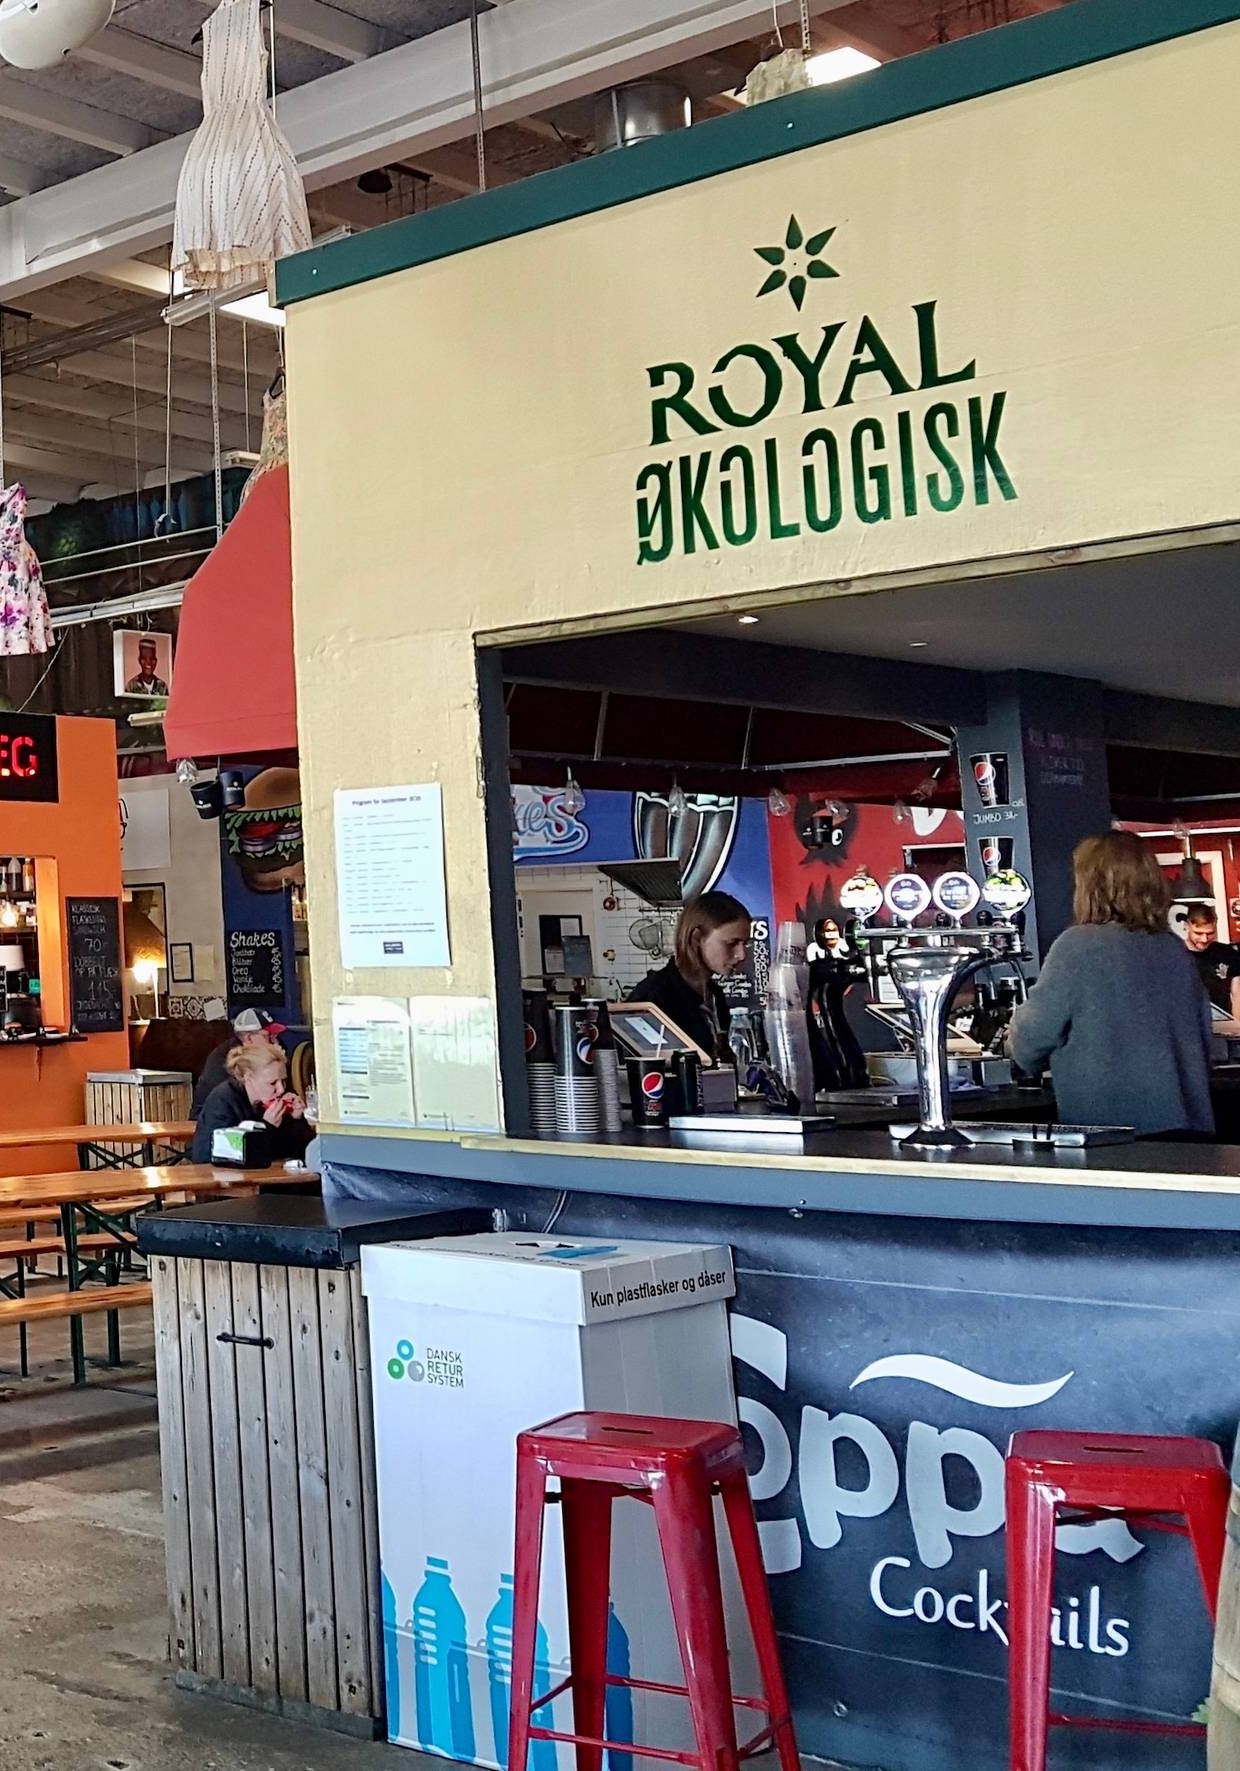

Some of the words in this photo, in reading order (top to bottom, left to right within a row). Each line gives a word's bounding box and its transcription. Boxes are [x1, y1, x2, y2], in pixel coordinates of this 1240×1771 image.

[646, 300, 976, 446] ROYAL
[636, 391, 1018, 565] ØKOLOGISK
[230, 931, 275, 948] Shakes
[590, 1291, 614, 1308] Kun
[616, 1280, 679, 1306] plastflasker
[682, 1278, 696, 1293] og
[698, 1270, 726, 1288] dåser
[427, 1347, 462, 1363] DANSK
[427, 1360, 463, 1377] RETUR
[427, 1373, 464, 1389] SYSTEM
